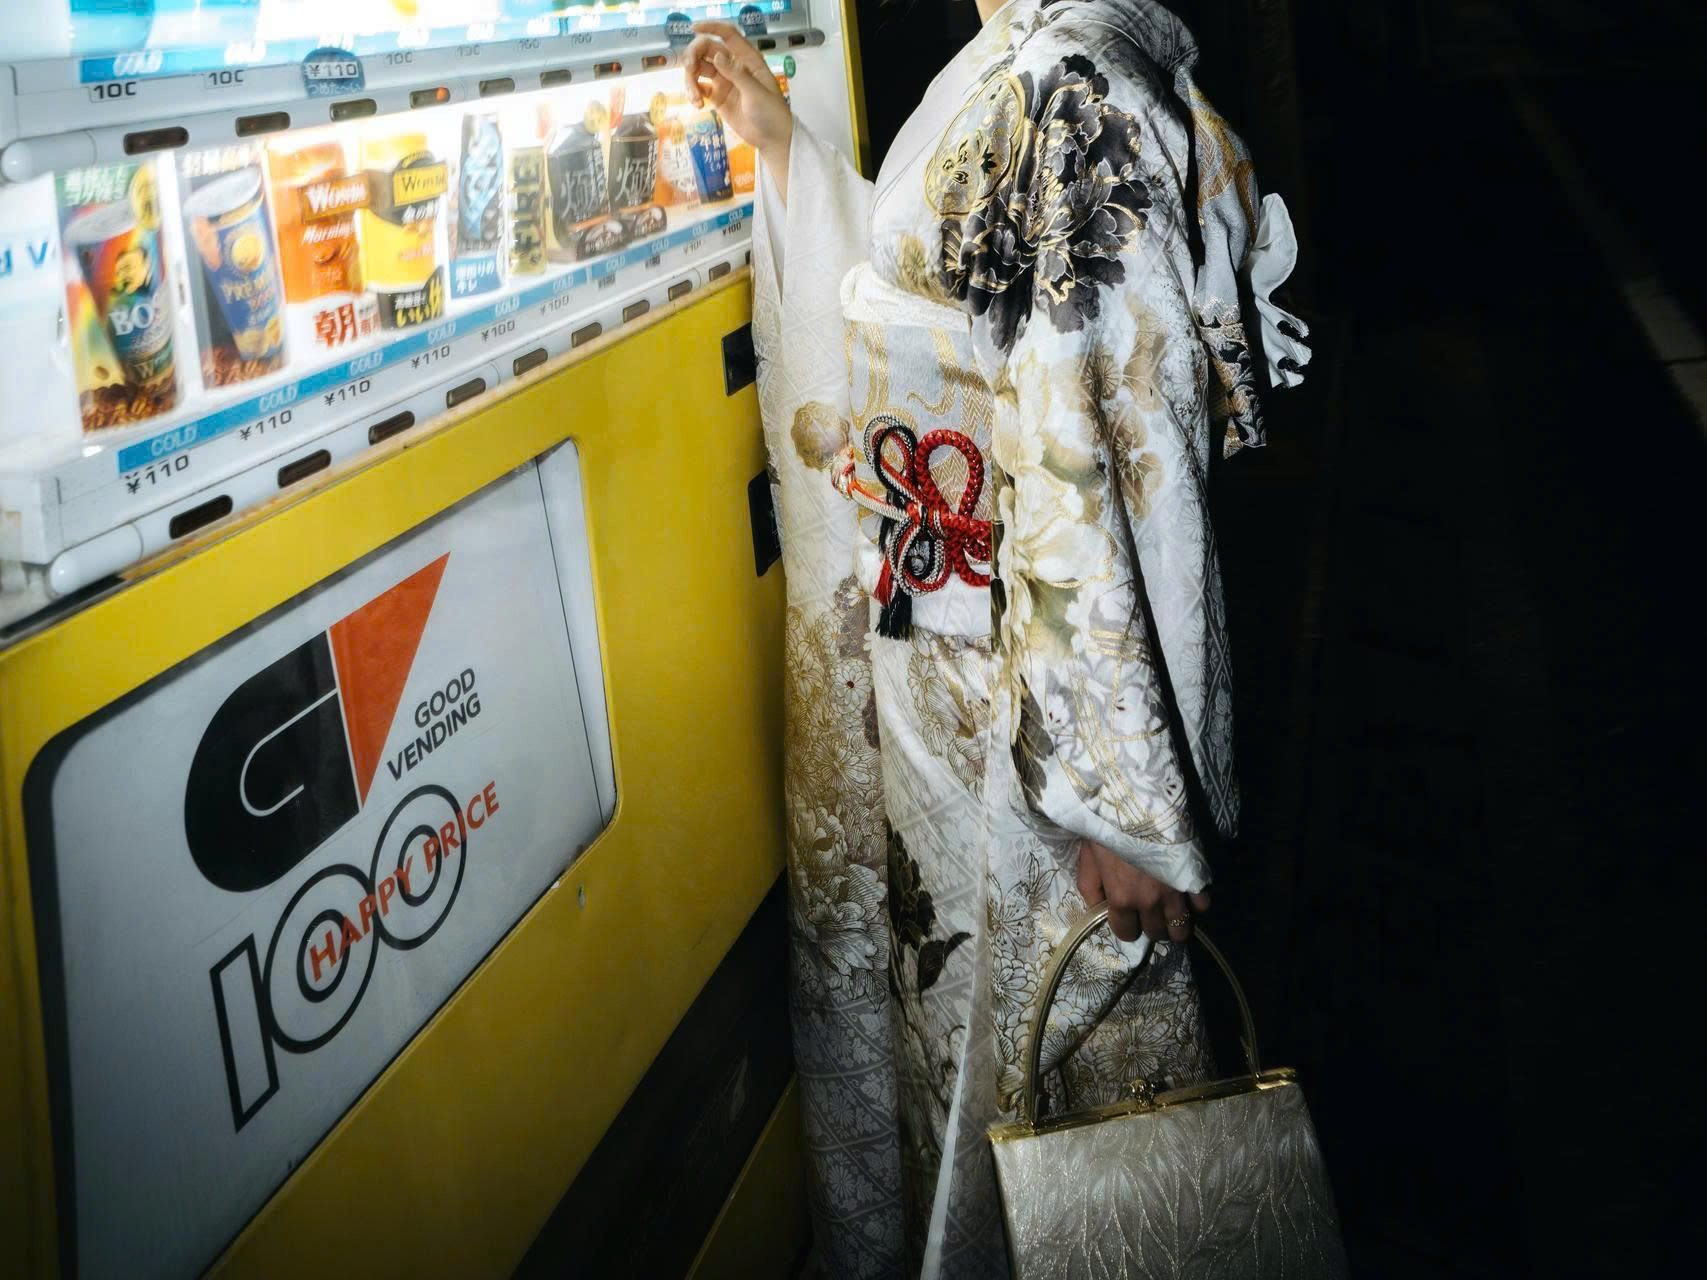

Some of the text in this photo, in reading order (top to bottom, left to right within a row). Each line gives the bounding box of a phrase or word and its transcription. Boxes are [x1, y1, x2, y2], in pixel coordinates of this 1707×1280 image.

[308, 63, 357, 78] ¥110
[495, 296, 520, 317] COLD
[428, 322, 456, 344] COLD
[481, 320, 516, 341] ¥100
[350, 351, 384, 377] COLD
[411, 345, 450, 369] ¥110
[259, 383, 298, 412] COLD
[325, 380, 370, 406] ¥110
[239, 408, 292, 442] ¥110
[151, 424, 199, 458] COLD
[126, 454, 190, 494] ¥110
[415, 667, 477, 729] GOOD
[387, 692, 482, 783] VENDING
[310, 781, 500, 983] HAPPY PRICE
[210, 784, 467, 1134] 100
